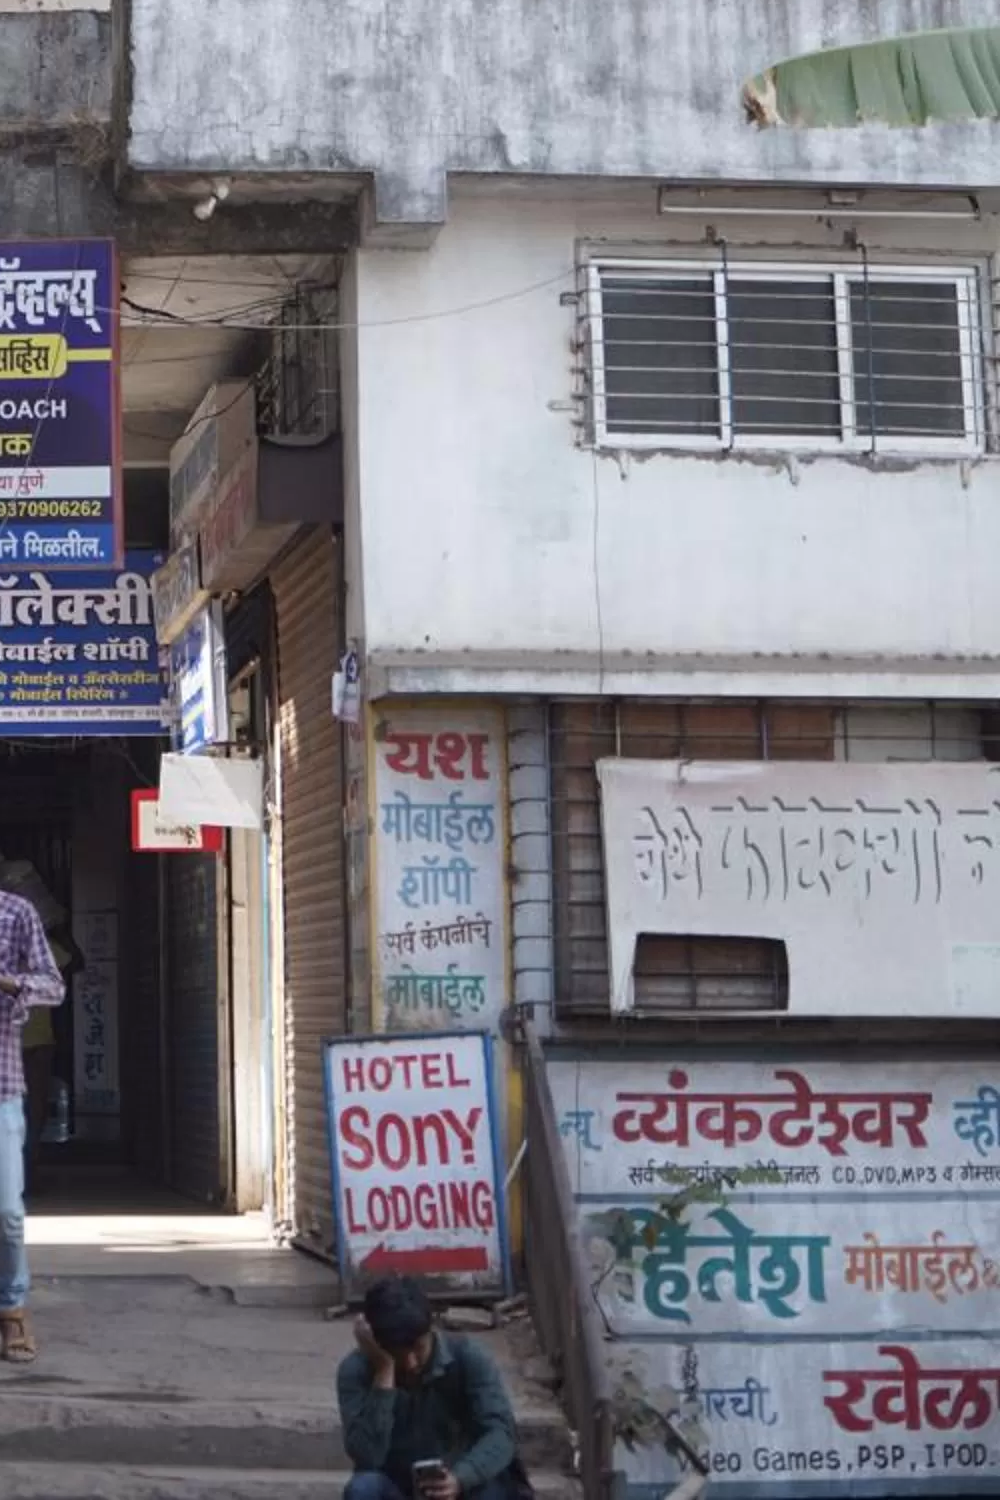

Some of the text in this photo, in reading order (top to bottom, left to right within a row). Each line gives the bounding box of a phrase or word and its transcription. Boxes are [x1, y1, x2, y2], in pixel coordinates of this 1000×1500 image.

[83, 636, 149, 661] शॉपी
[383, 731, 490, 781] यश
[381, 790, 495, 852] मोबाईल
[398, 855, 477, 909] शॉपी
[342, 1052, 471, 1093] HOTEL
[345, 1180, 494, 1235] LODGING
[843, 1229, 979, 1304] मोबाईल
[677, 1449, 742, 1474] Vdeo
